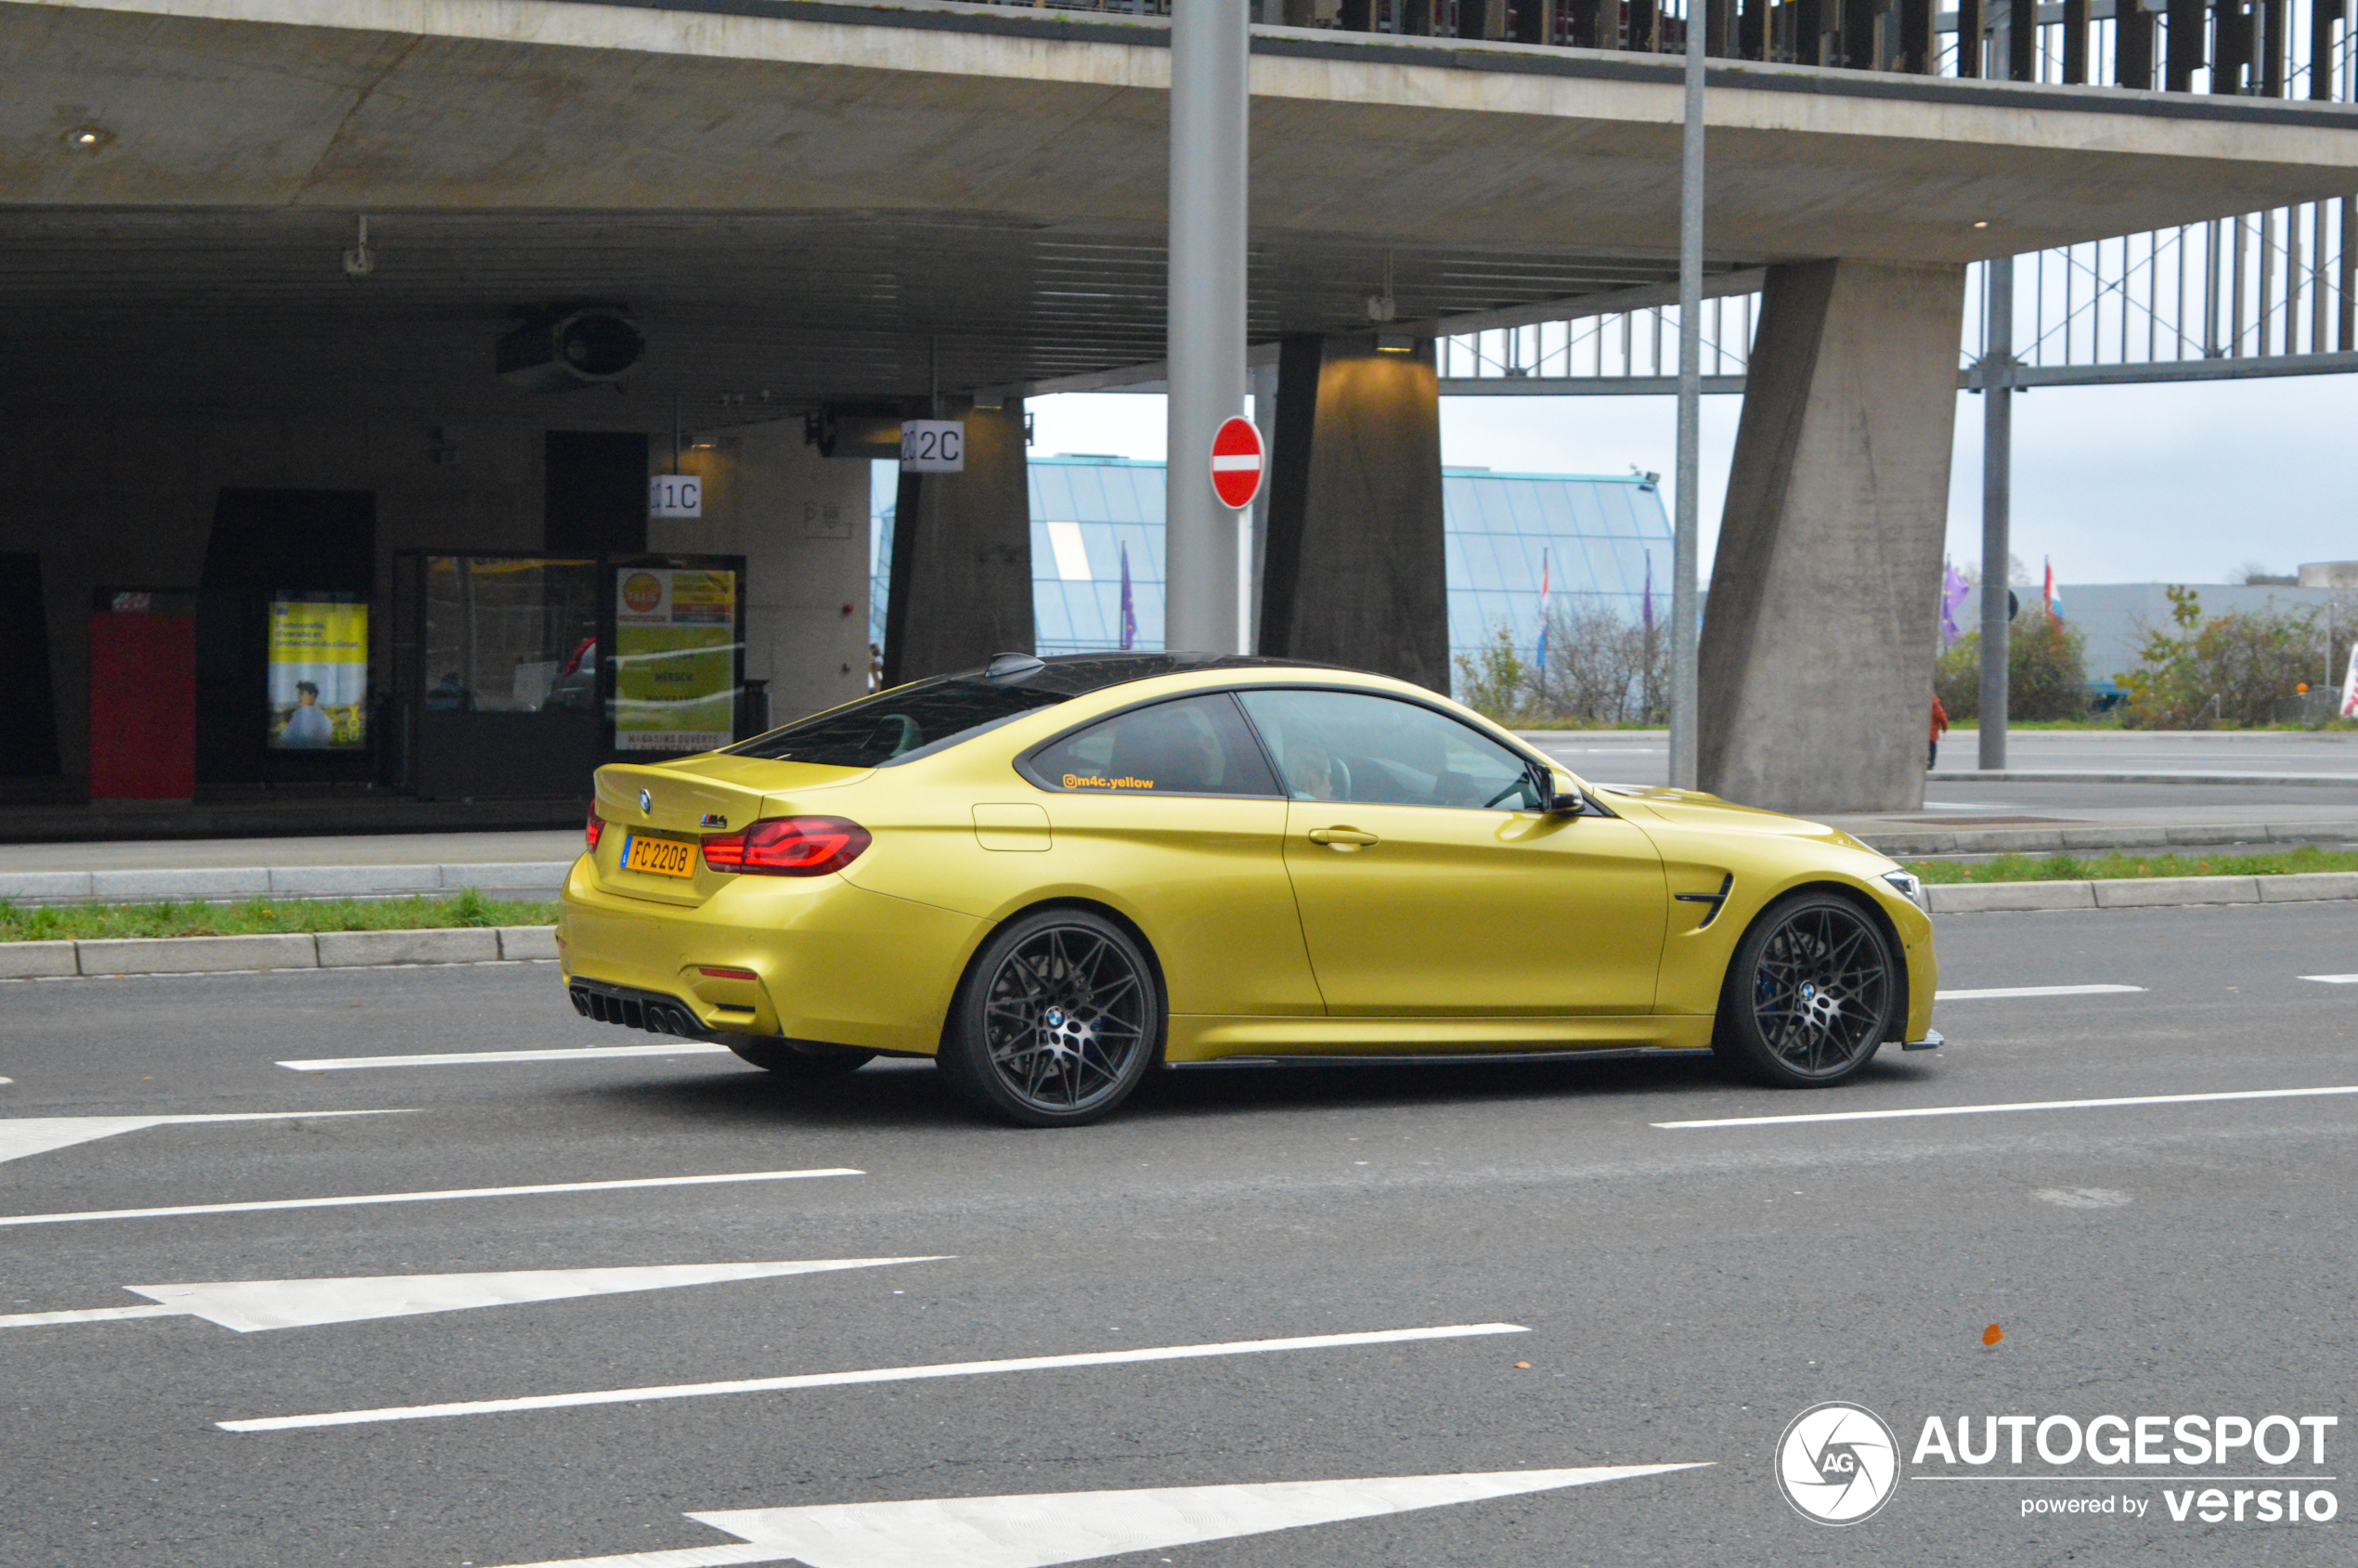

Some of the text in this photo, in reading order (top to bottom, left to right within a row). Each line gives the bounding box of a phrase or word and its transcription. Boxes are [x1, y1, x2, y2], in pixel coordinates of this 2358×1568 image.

[921, 431, 959, 460] 2C
[666, 484, 697, 509] 1C
[1077, 775, 1154, 790] m4c.yellow
